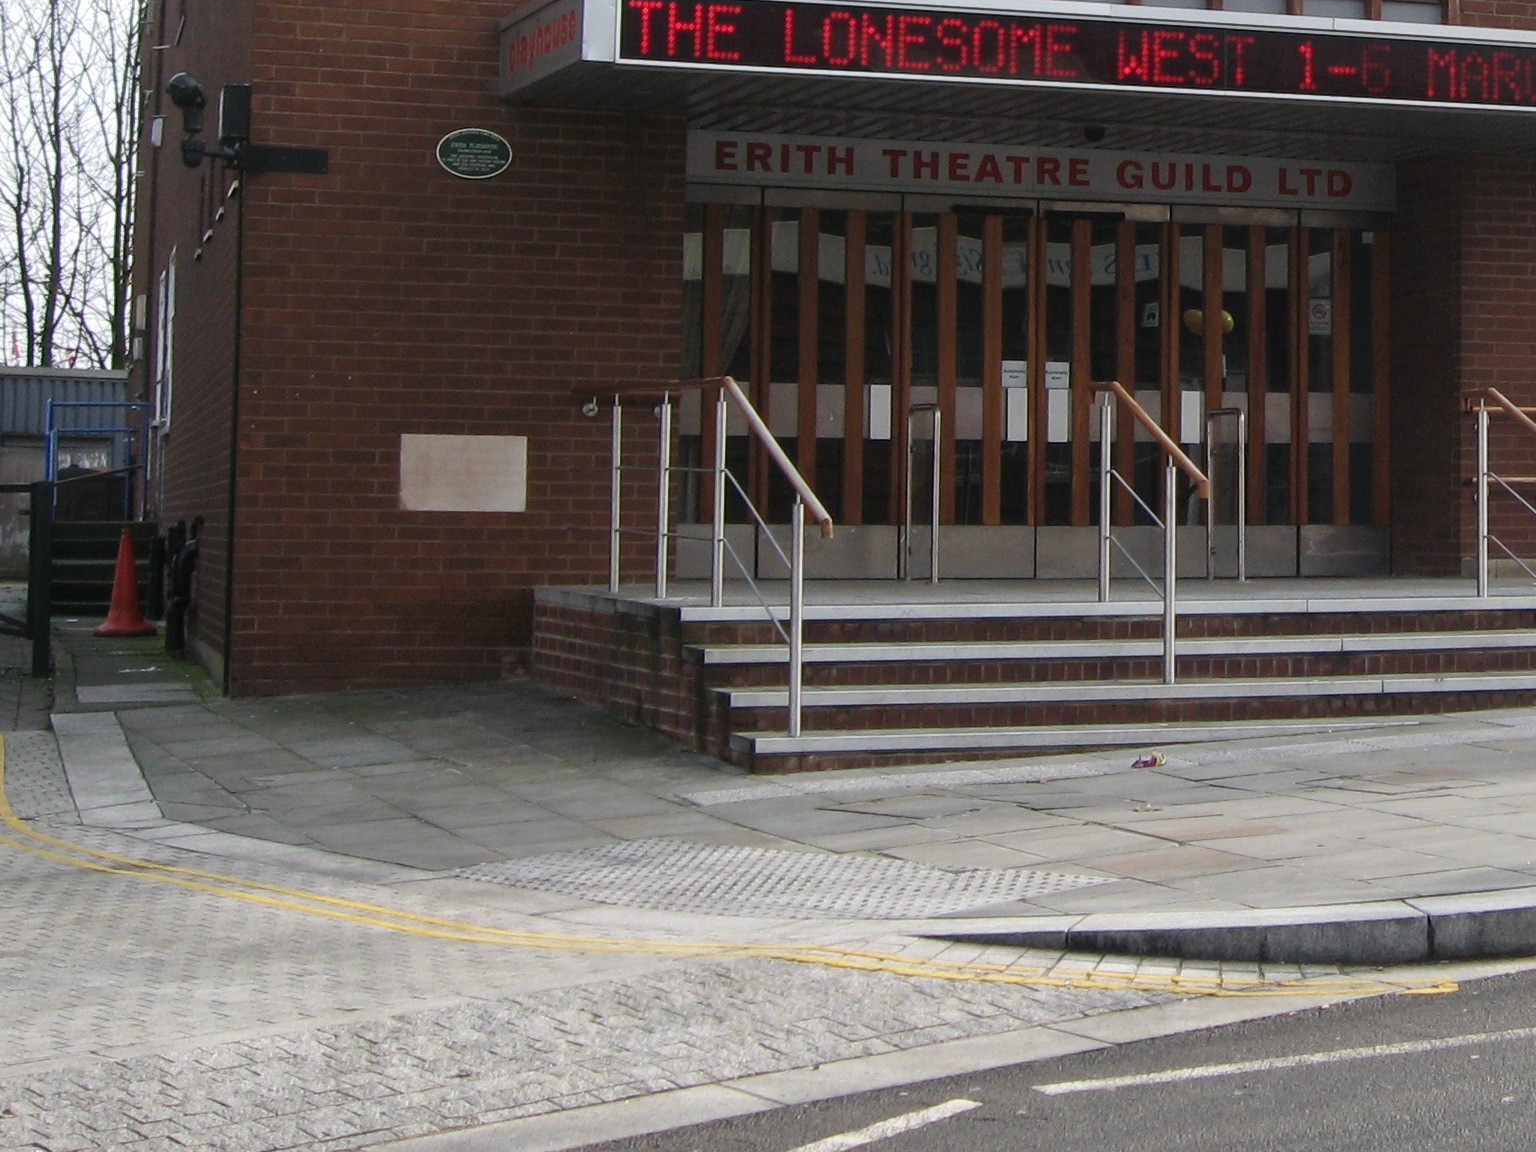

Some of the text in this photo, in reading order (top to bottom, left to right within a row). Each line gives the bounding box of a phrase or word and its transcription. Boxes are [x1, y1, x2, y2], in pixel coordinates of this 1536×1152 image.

[506, 9, 577, 80] playhouse
[784, 8, 1078, 77] LONESOME
[1117, 29, 1257, 87] WEST
[714, 140, 1354, 198] ERITH THEATRE GUILD LTD
